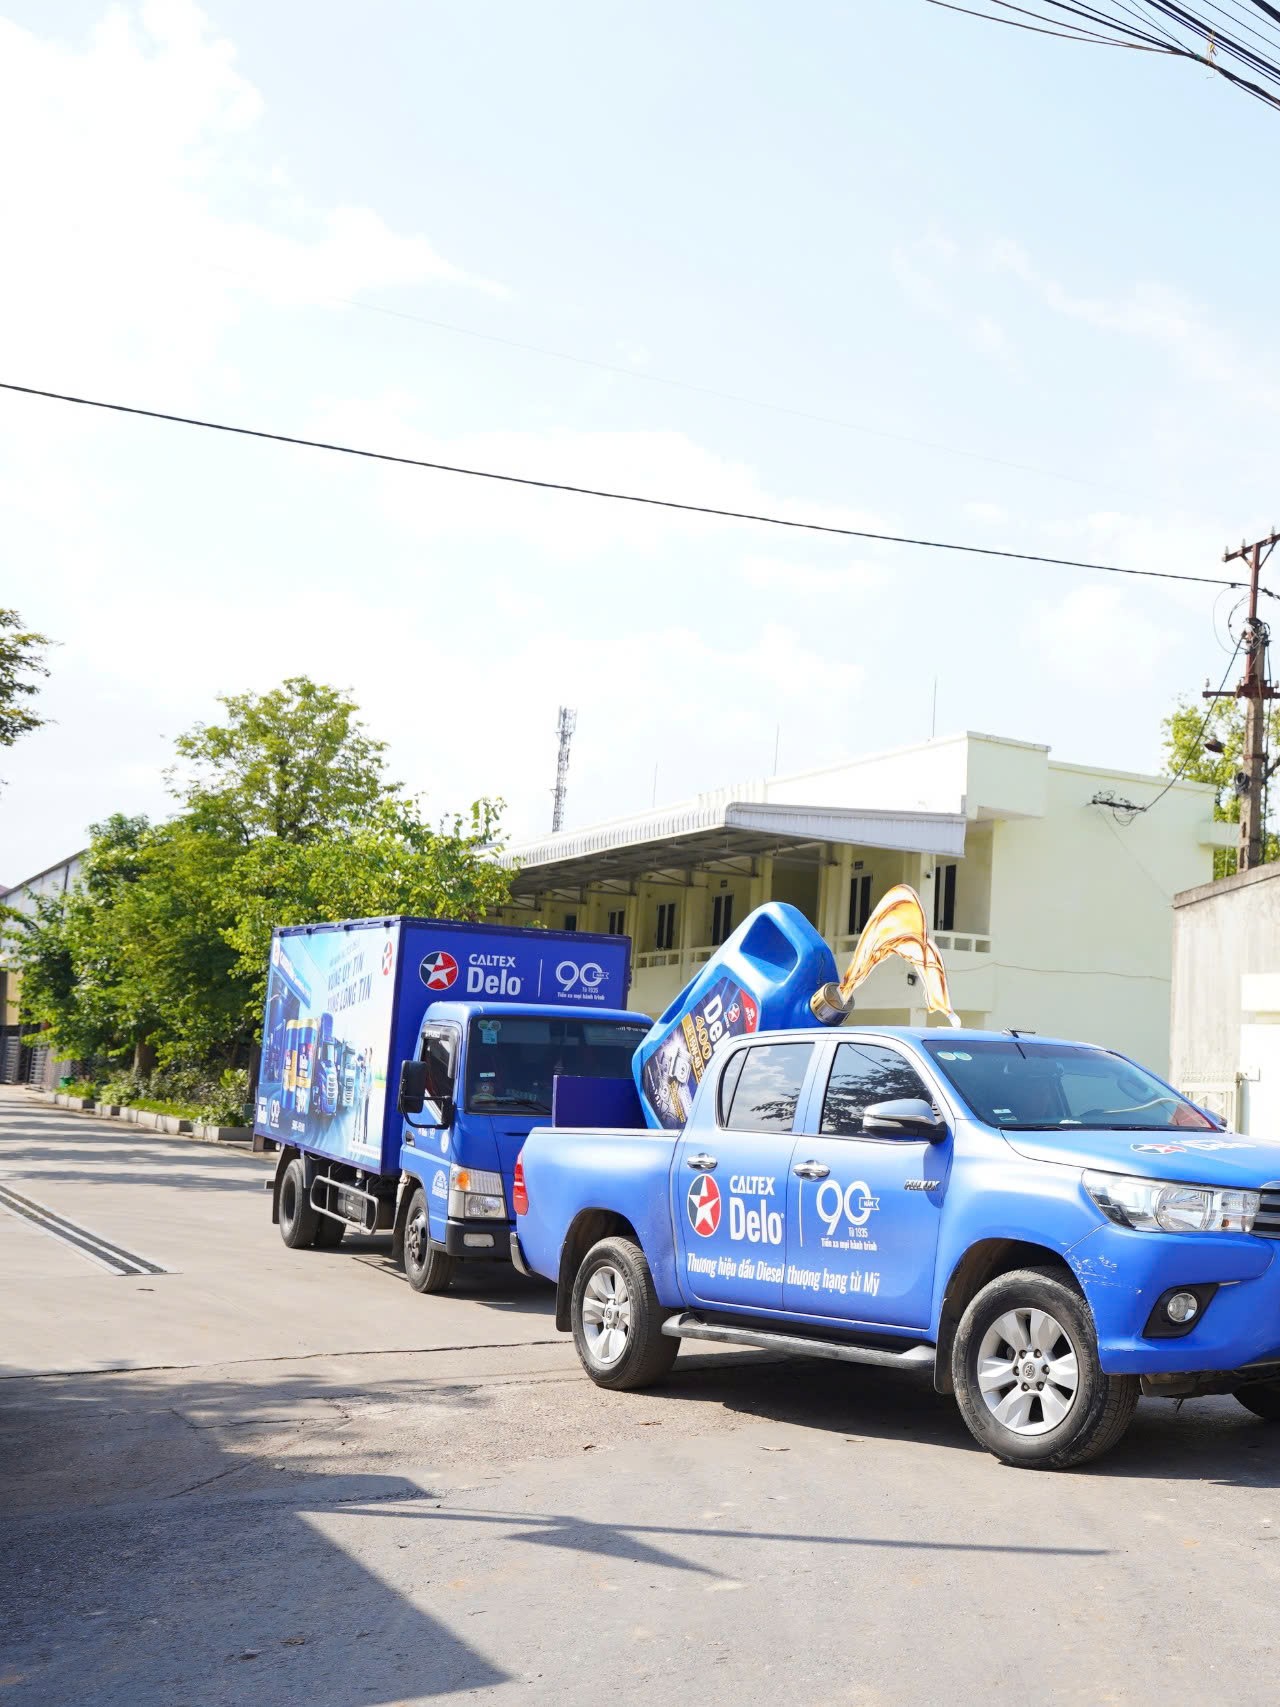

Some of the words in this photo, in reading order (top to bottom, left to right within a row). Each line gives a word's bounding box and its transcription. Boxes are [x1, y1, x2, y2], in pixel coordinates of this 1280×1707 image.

[468, 954, 516, 968] CALTEX
[556, 961, 603, 992] 90
[466, 966, 521, 996] Delo
[695, 1015, 712, 1060] 400
[704, 994, 731, 1052] Del
[730, 1175, 776, 1196] CALTEX
[730, 1196, 783, 1245] Delo
[816, 1180, 872, 1236] 90
[855, 1227, 868, 1238] 1935
[687, 1253, 716, 1278] Thương
[718, 1256, 736, 1280] hiệu
[738, 1258, 755, 1280] dầu
[756, 1260, 784, 1284] Diesel
[787, 1264, 820, 1291] thượng
[822, 1268, 847, 1294] hạng
[850, 1270, 862, 1291] từ
[864, 1271, 880, 1296] Mỹ
